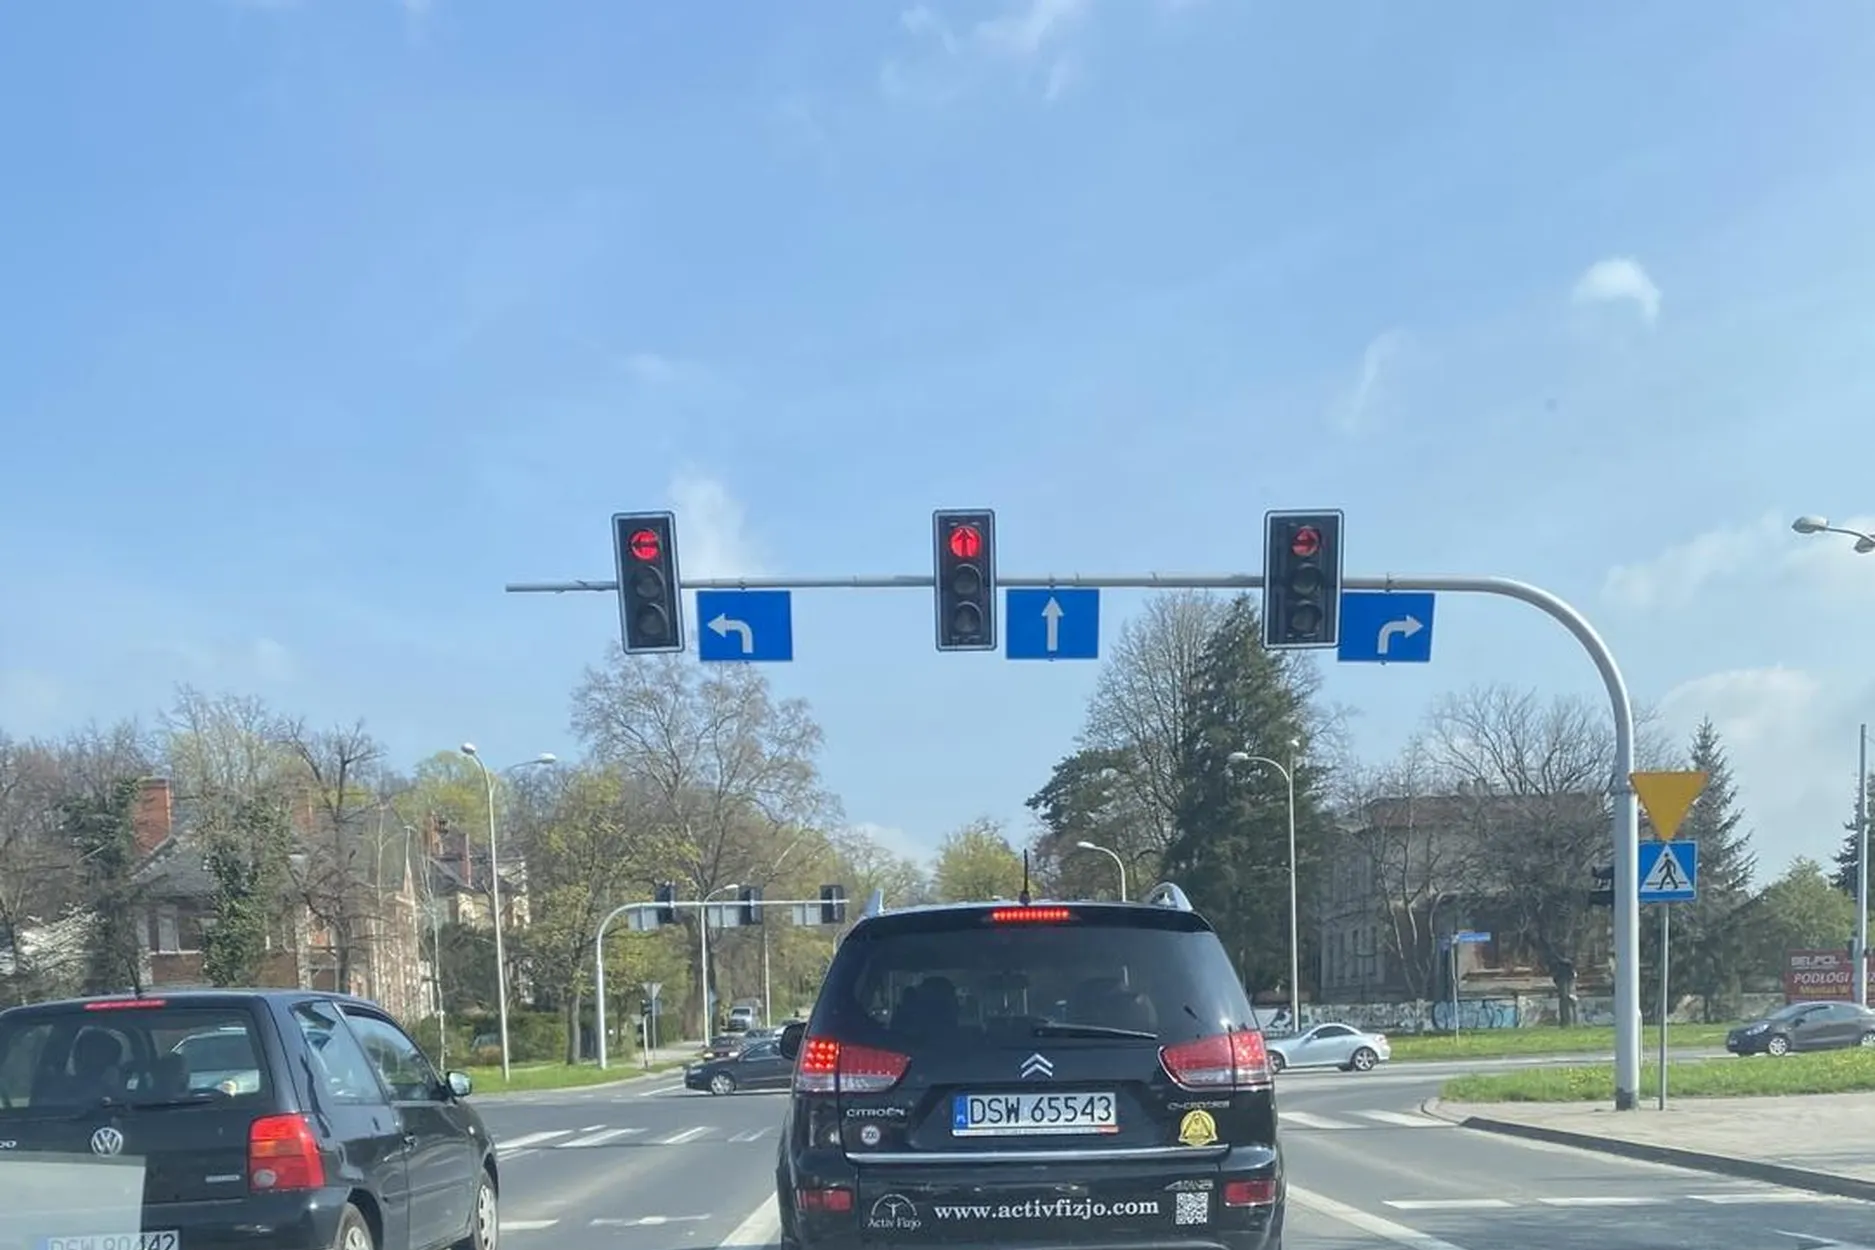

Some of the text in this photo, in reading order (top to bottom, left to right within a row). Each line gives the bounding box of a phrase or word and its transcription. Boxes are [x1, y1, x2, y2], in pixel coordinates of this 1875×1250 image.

[970, 1095, 1112, 1124] DSW 65543
[934, 1198, 1159, 1220] www.activfizjo.com
